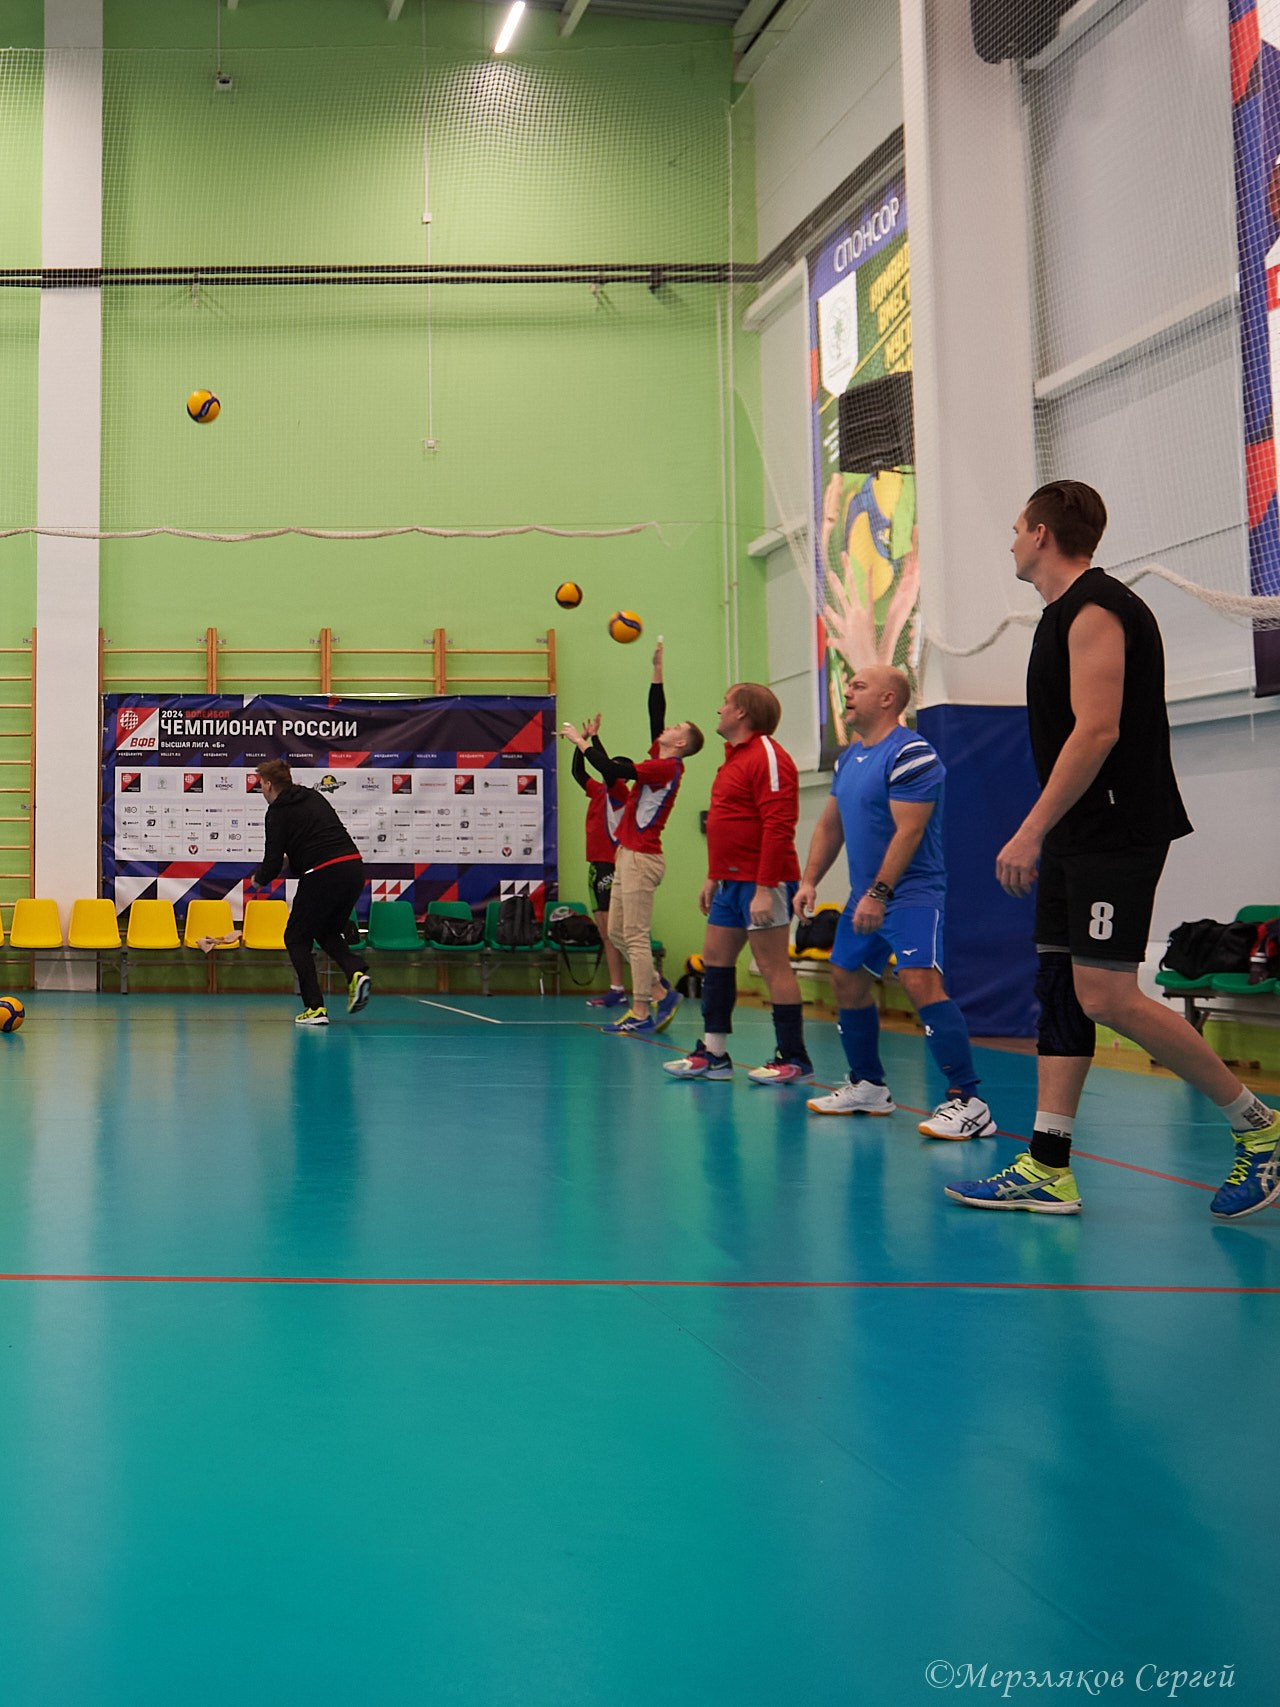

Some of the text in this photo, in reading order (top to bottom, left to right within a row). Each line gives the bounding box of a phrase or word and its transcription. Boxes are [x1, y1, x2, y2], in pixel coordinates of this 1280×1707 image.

[833, 197, 899, 273] СПОНСОР
[161, 709, 230, 718] 2024 ВОЛЕЙБОЛ
[161, 719, 358, 737] ЧЕМПИОНАТ РОССИИ
[130, 737, 156, 748] ВФВ
[1088, 901, 1115, 940] 8
